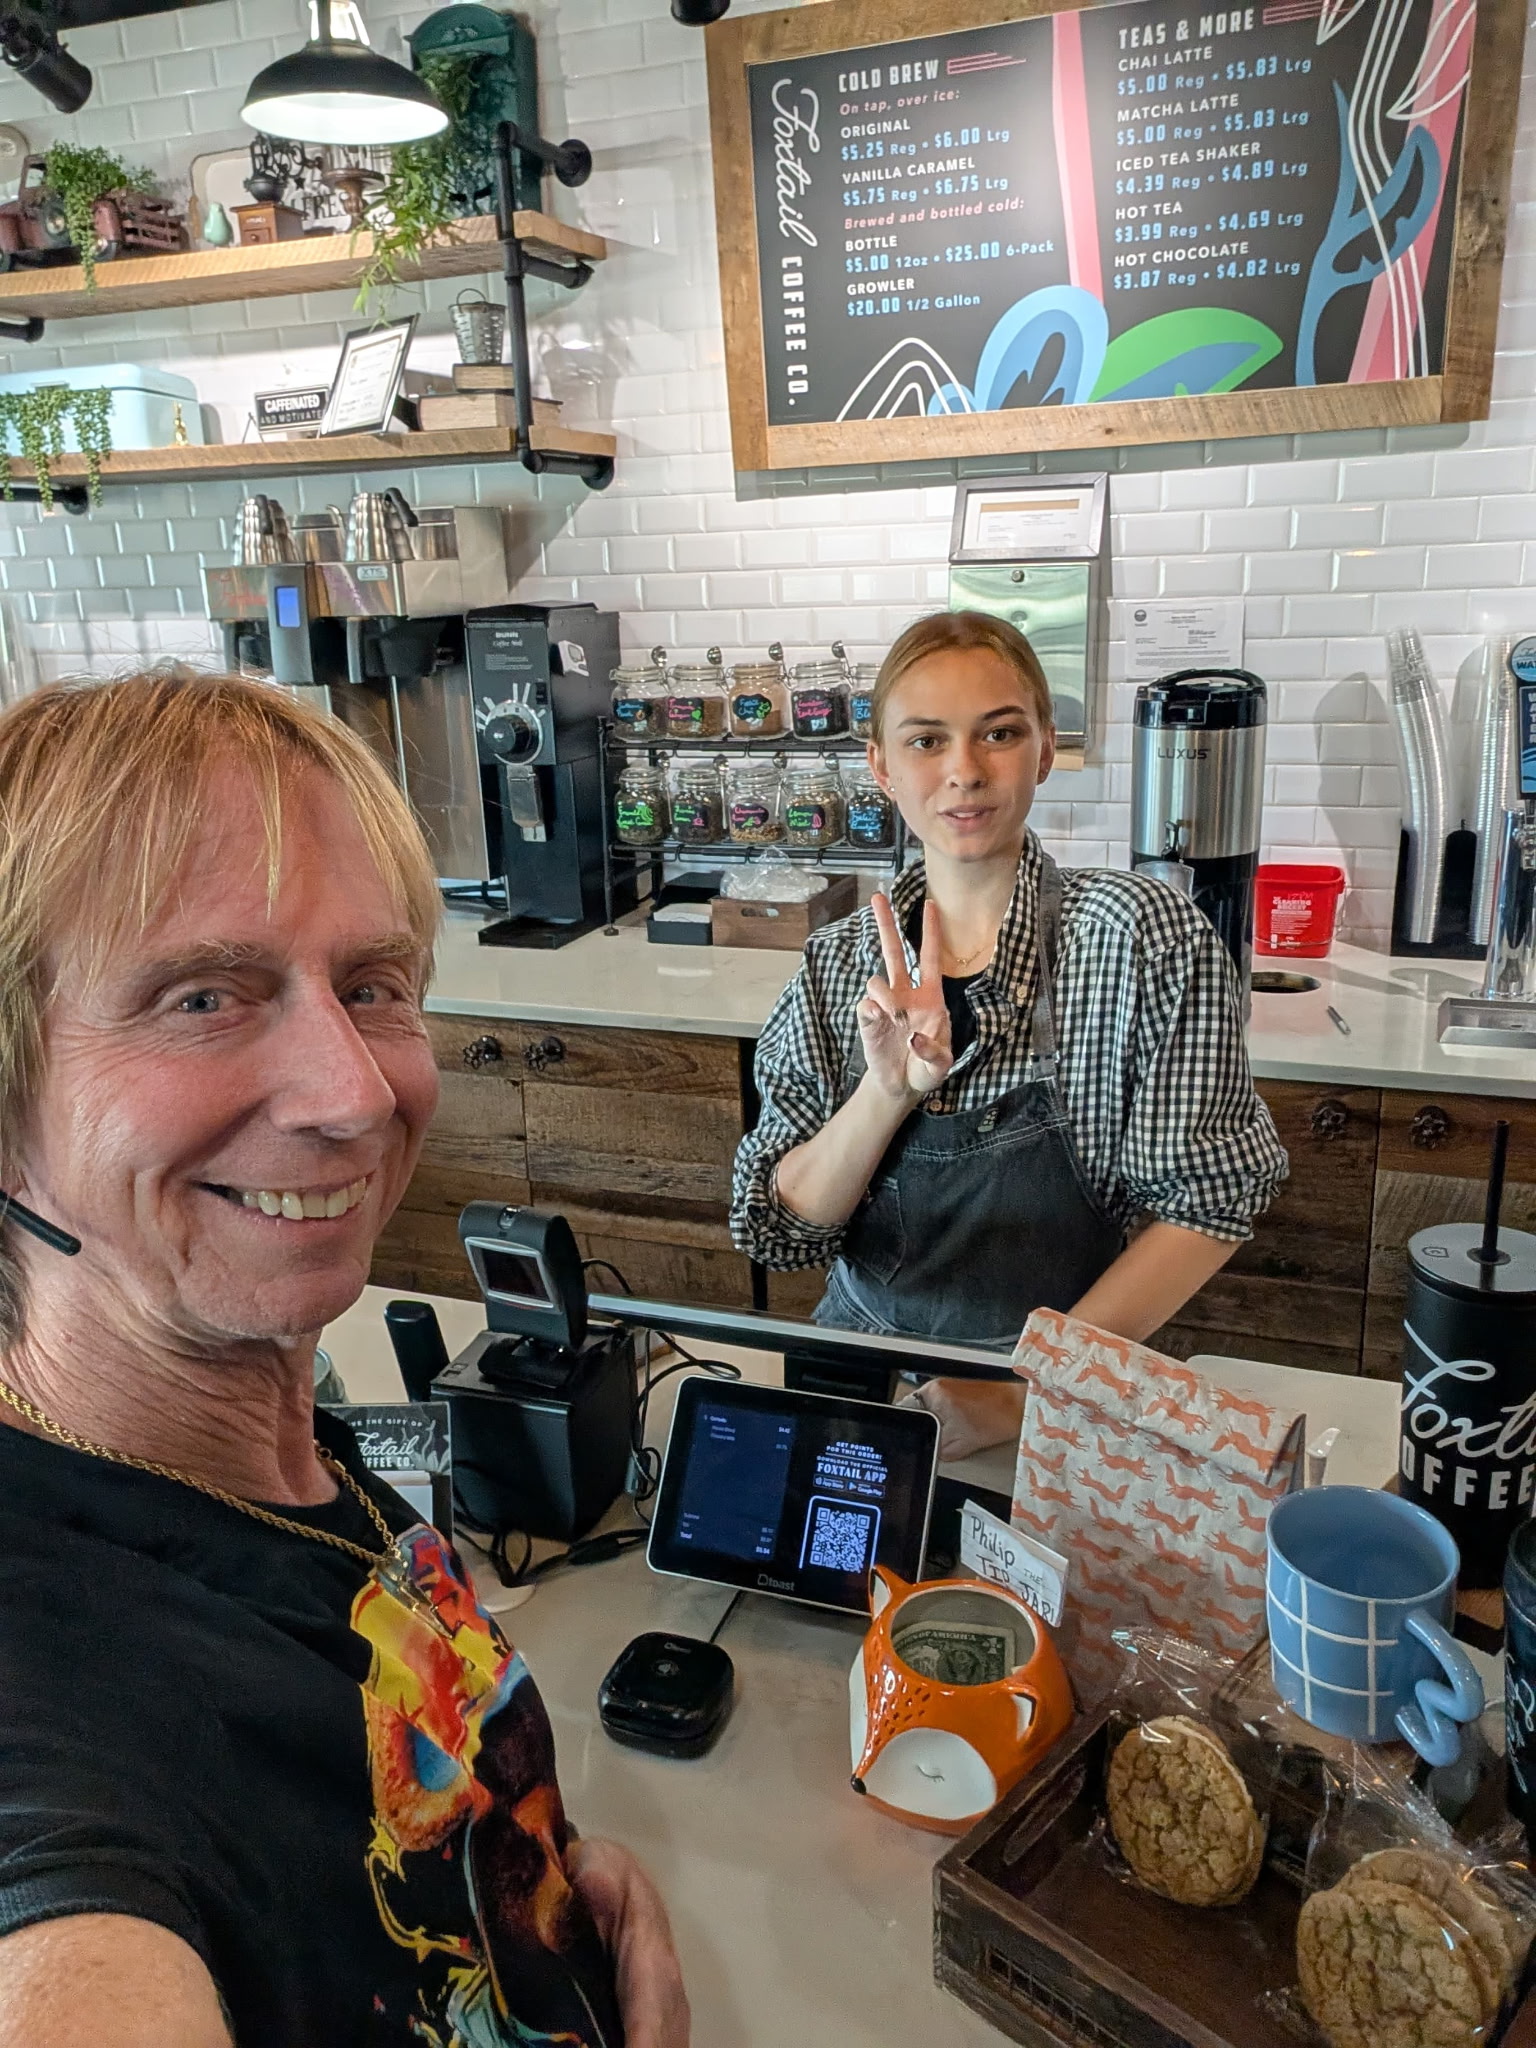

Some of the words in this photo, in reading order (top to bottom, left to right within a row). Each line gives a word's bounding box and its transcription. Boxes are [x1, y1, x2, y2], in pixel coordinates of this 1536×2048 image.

[1119, 23, 1166, 49] TEAS
[1176, 20, 1189, 41] &
[1200, 9, 1254, 38] MORE
[1118, 54, 1157, 72] CHAI
[1164, 47, 1212, 65] LATTE
[839, 67, 881, 93] COLD
[890, 59, 940, 86] BREW
[1118, 73, 1168, 96] $5.00
[1176, 75, 1204, 88] Reg
[1286, 58, 1311, 73] Lrg
[840, 101, 861, 115] On
[864, 98, 892, 114] tap,
[897, 94, 925, 108] over
[929, 90, 960, 103] ice:
[1117, 103, 1183, 122] MATCHA
[1190, 94, 1239, 112] LATTE
[841, 119, 911, 139] ORIGINAL
[1117, 124, 1166, 146] $5.00
[1174, 127, 1202, 141] Reg
[1282, 111, 1309, 125] Lrg
[841, 141, 884, 161] $5.25
[890, 141, 916, 157] Reg
[934, 128, 981, 149] $6.00
[987, 128, 1010, 144] Lrg
[1116, 155, 1153, 172] ICED
[1160, 152, 1190, 167] TEA
[1196, 142, 1261, 162] SHAKER
[772, 79, 821, 247] Foxtail
[842, 165, 902, 185] VANILLA
[907, 157, 975, 177] CARAMEL
[1116, 174, 1164, 195] $4.39
[1172, 177, 1200, 189] Reg
[1282, 162, 1308, 177] Lrg
[843, 187, 885, 207] $5.75
[891, 187, 917, 203] Reg
[935, 176, 979, 196] $6.75
[985, 177, 1008, 193] Lrg
[844, 212, 895, 230] Brewed
[900, 209, 925, 224] and
[930, 202, 983, 221] bottled
[988, 198, 1024, 213] cold:
[1116, 206, 1148, 220] HOT
[1154, 202, 1183, 216] TEA
[1115, 223, 1162, 243] $3.99
[1170, 226, 1197, 239] Reg
[1219, 210, 1270, 231] $4.69
[1278, 213, 1303, 227] Lrg
[845, 235, 898, 252] BOTTLE
[1114, 253, 1148, 267] HOT
[1152, 242, 1249, 262] CHOCOLATE
[845, 254, 889, 273] $5.00
[896, 255, 928, 269] 12oz
[945, 242, 1000, 264] $25.00
[1006, 240, 1054, 257] 6-Pack
[1168, 272, 1196, 286] Reg
[1275, 261, 1300, 275] Lrg
[847, 278, 914, 296] GROWLER
[781, 256, 807, 352] COFFEE
[847, 297, 900, 318] $20.00
[906, 299, 929, 312] 1/2
[934, 294, 981, 309] Gallon
[787, 365, 808, 406] CO.
[265, 394, 320, 413] CAFFEINATED
[261, 415, 276, 424] AND
[279, 410, 323, 423] MOTIVATE
[1158, 748, 1210, 760] LUXUS
[355, 1432, 419, 1456] Foxtail
[851, 1444, 874, 1452] POINTS
[397, 1457, 414, 1467] CO.
[817, 1456, 848, 1466] DOWNLOAD
[862, 1464, 888, 1473] OFFICIAL
[817, 1463, 861, 1479] FOXTAIL
[864, 1471, 886, 1483] APP
[971, 1516, 1015, 1568] Philip
[768, 1578, 795, 1591] toast
[1024, 1568, 1042, 1584] THE
